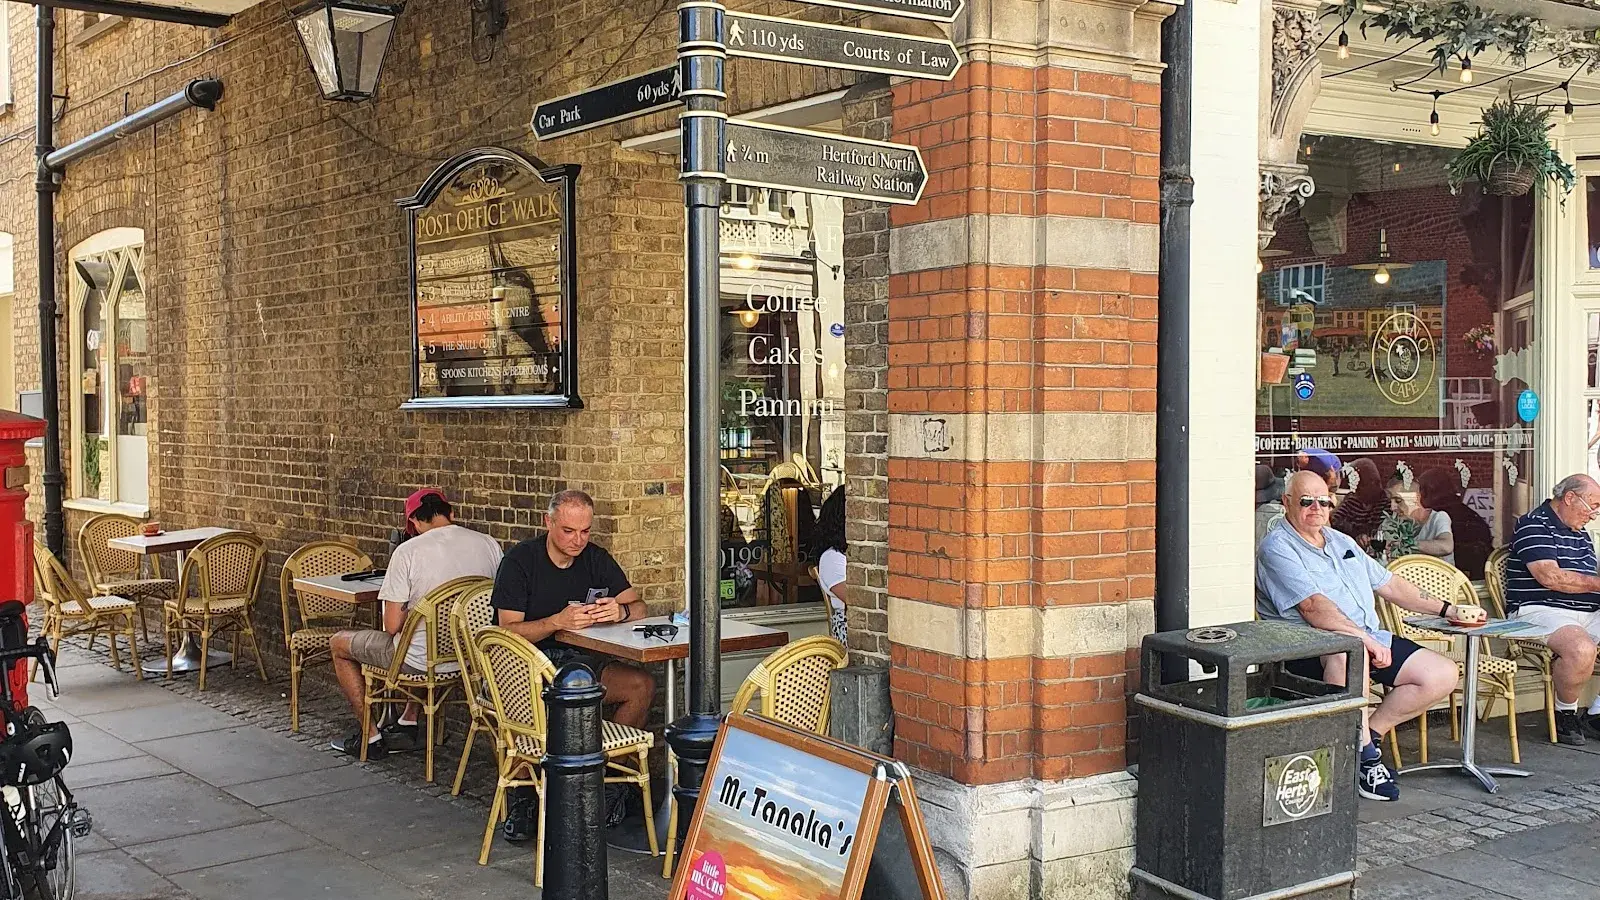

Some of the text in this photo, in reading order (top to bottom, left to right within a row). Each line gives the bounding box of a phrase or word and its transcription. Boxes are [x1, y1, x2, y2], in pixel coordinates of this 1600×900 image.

[751, 29, 805, 53] 110 yds
[843, 41, 950, 69] Courts of Law
[637, 80, 670, 104] 60 yds
[538, 105, 581, 130] Car Park
[756, 150, 769, 164] m
[821, 144, 915, 172] Hertford North
[816, 166, 915, 194] Railway Station
[418, 191, 560, 239] POST OFFICE WALK
[428, 286, 436, 301] 3
[746, 283, 828, 313] Coffee
[428, 306, 530, 327] 4 ABILITY BUSINESS CENTRE
[428, 338, 498, 355] 5 THE SKULL CLUB
[748, 335, 825, 365] Cakes
[428, 367, 436, 382] 6
[441, 367, 467, 379] SPOONS
[467, 366, 501, 378] KITCHENS
[509, 364, 549, 377] BEDROOMS
[1390, 379, 1420, 398] CAFE
[738, 388, 835, 417] Pannini
[1260, 433, 1533, 450] COFFEE BREAKFAST PANINIS PASTA SANDWICHES DOLCI TAKE AWAY
[1284, 767, 1311, 785] East
[1276, 783, 1308, 801] Herts
[719, 775, 852, 855] Mr Tanaka's
[702, 860, 720, 878] little
[691, 869, 725, 896] moons
